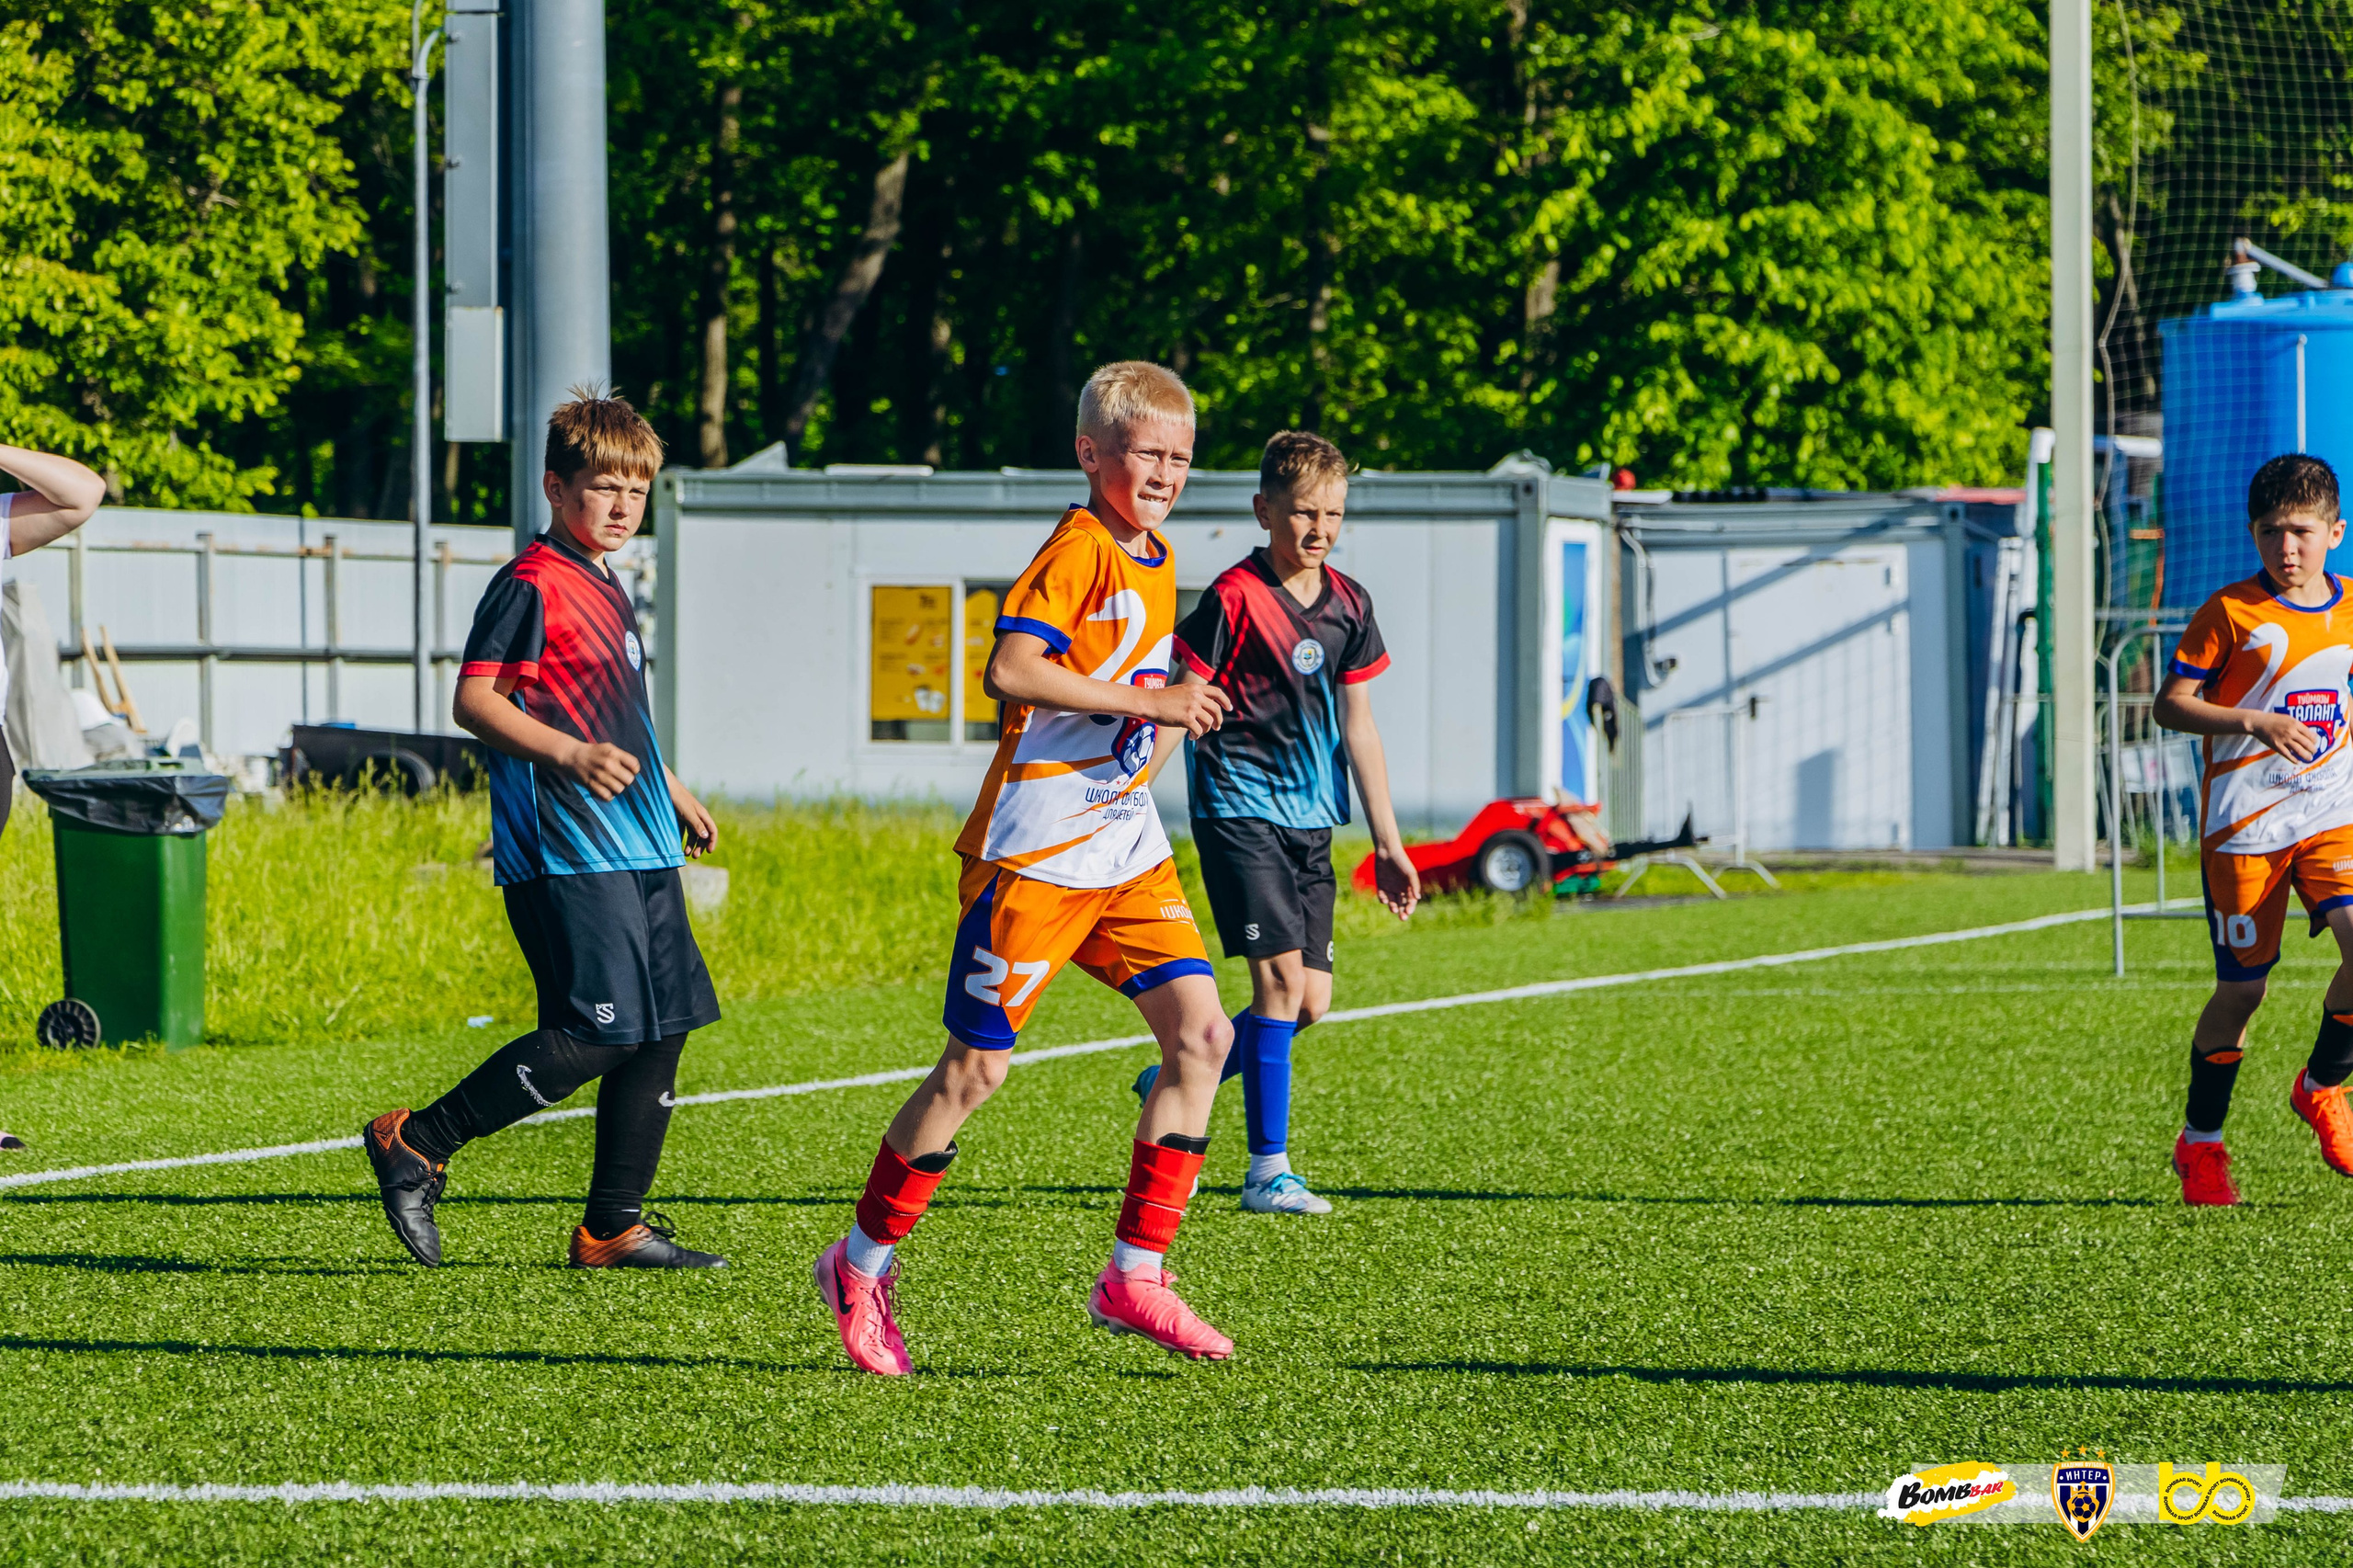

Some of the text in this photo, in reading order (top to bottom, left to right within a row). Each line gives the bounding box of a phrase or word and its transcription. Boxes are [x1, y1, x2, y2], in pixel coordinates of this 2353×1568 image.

[2287, 703, 2336, 722] ТАЛАНТ
[1086, 787, 1121, 806] ШКОЛА
[2214, 909, 2257, 948] 10
[964, 945, 1051, 1007] 27
